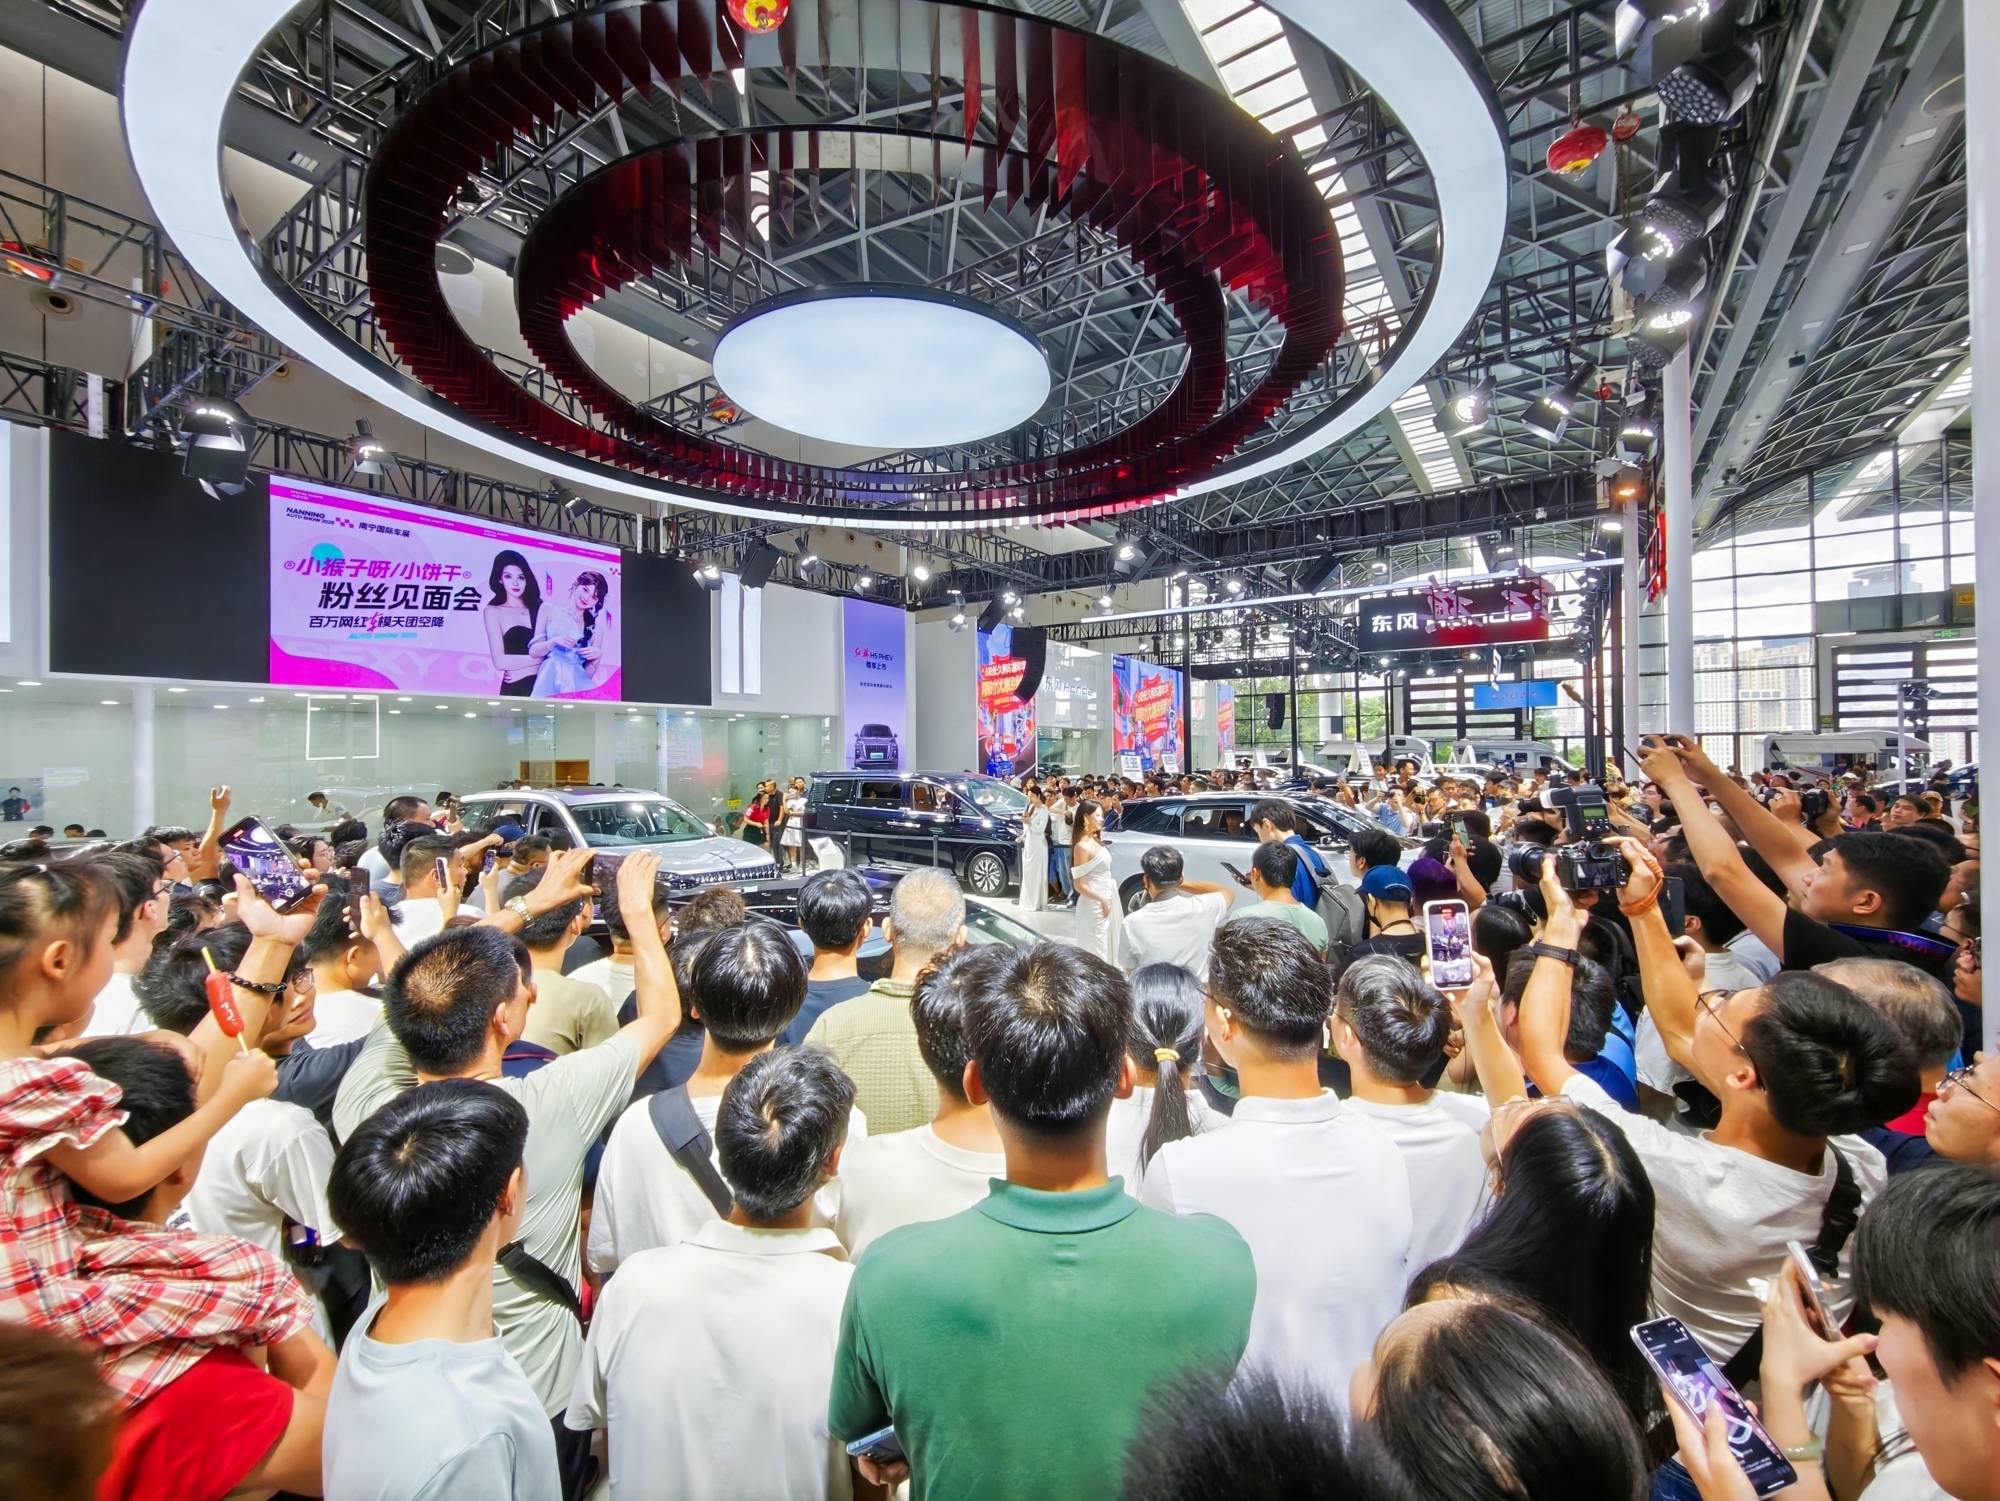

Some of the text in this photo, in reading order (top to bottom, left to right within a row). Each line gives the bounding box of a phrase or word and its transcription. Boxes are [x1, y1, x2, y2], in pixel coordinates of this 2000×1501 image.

[286, 507, 325, 519] NANNING
[303, 515, 321, 523] SHOW
[358, 521, 410, 538] 南宁国际车展
[296, 557, 462, 582] 小猴子呀/小饼干
[318, 581, 482, 611] 粉丝见面会
[309, 611, 445, 632] 百万网红车模天团空降
[1371, 612, 1419, 633] 东风
[878, 653, 894, 661] PHEV
